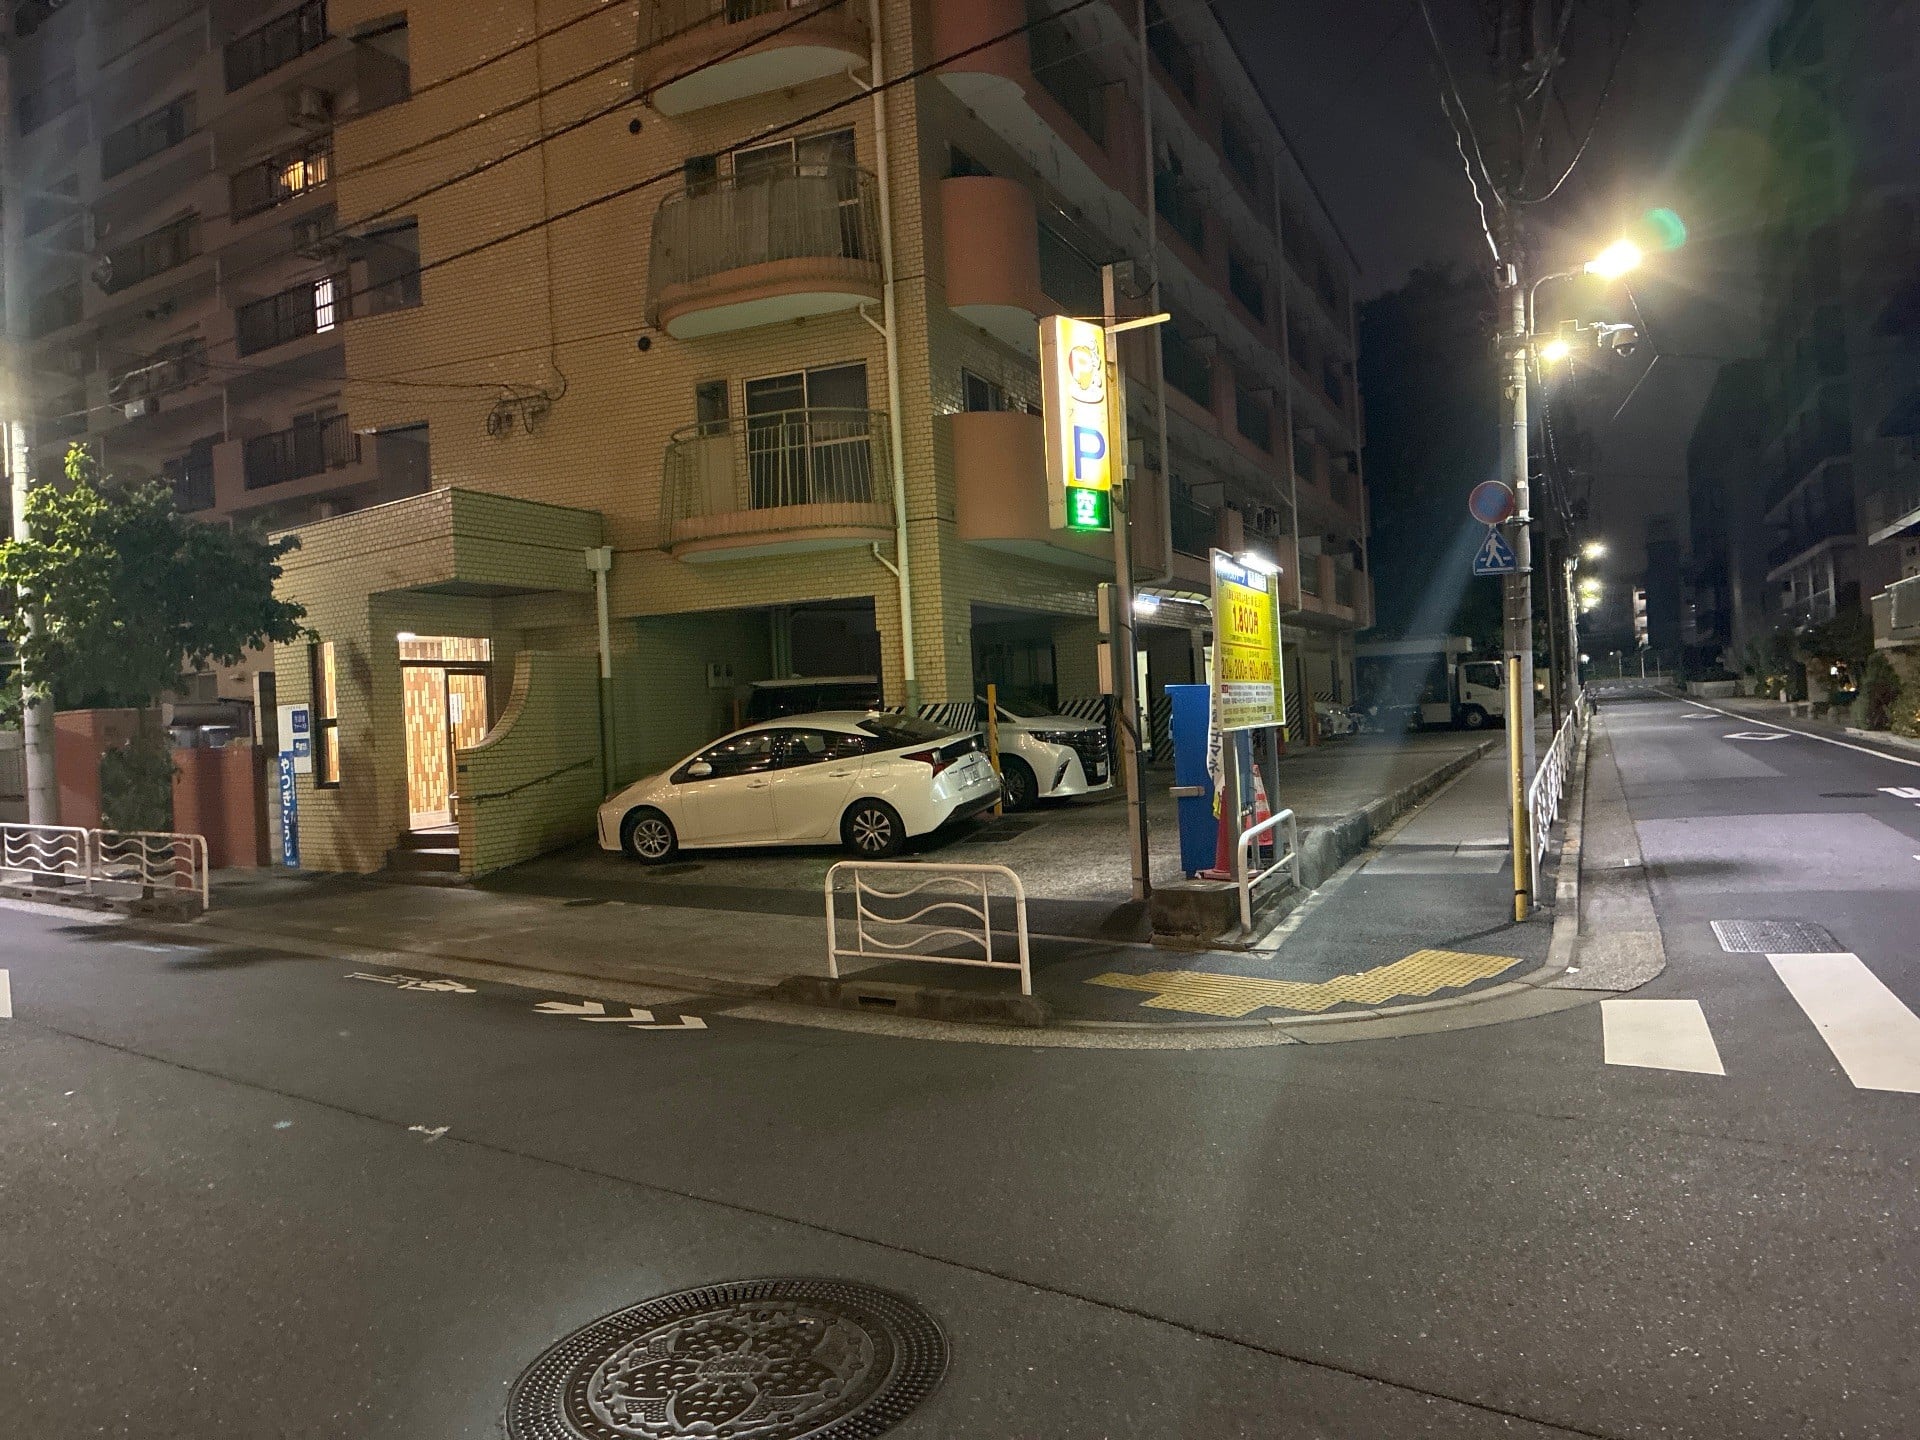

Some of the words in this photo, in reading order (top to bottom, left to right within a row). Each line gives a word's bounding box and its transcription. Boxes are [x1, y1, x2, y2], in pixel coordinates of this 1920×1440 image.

[1074, 425, 1105, 480] P
[280, 758, 293, 857] やつぎこうじ
